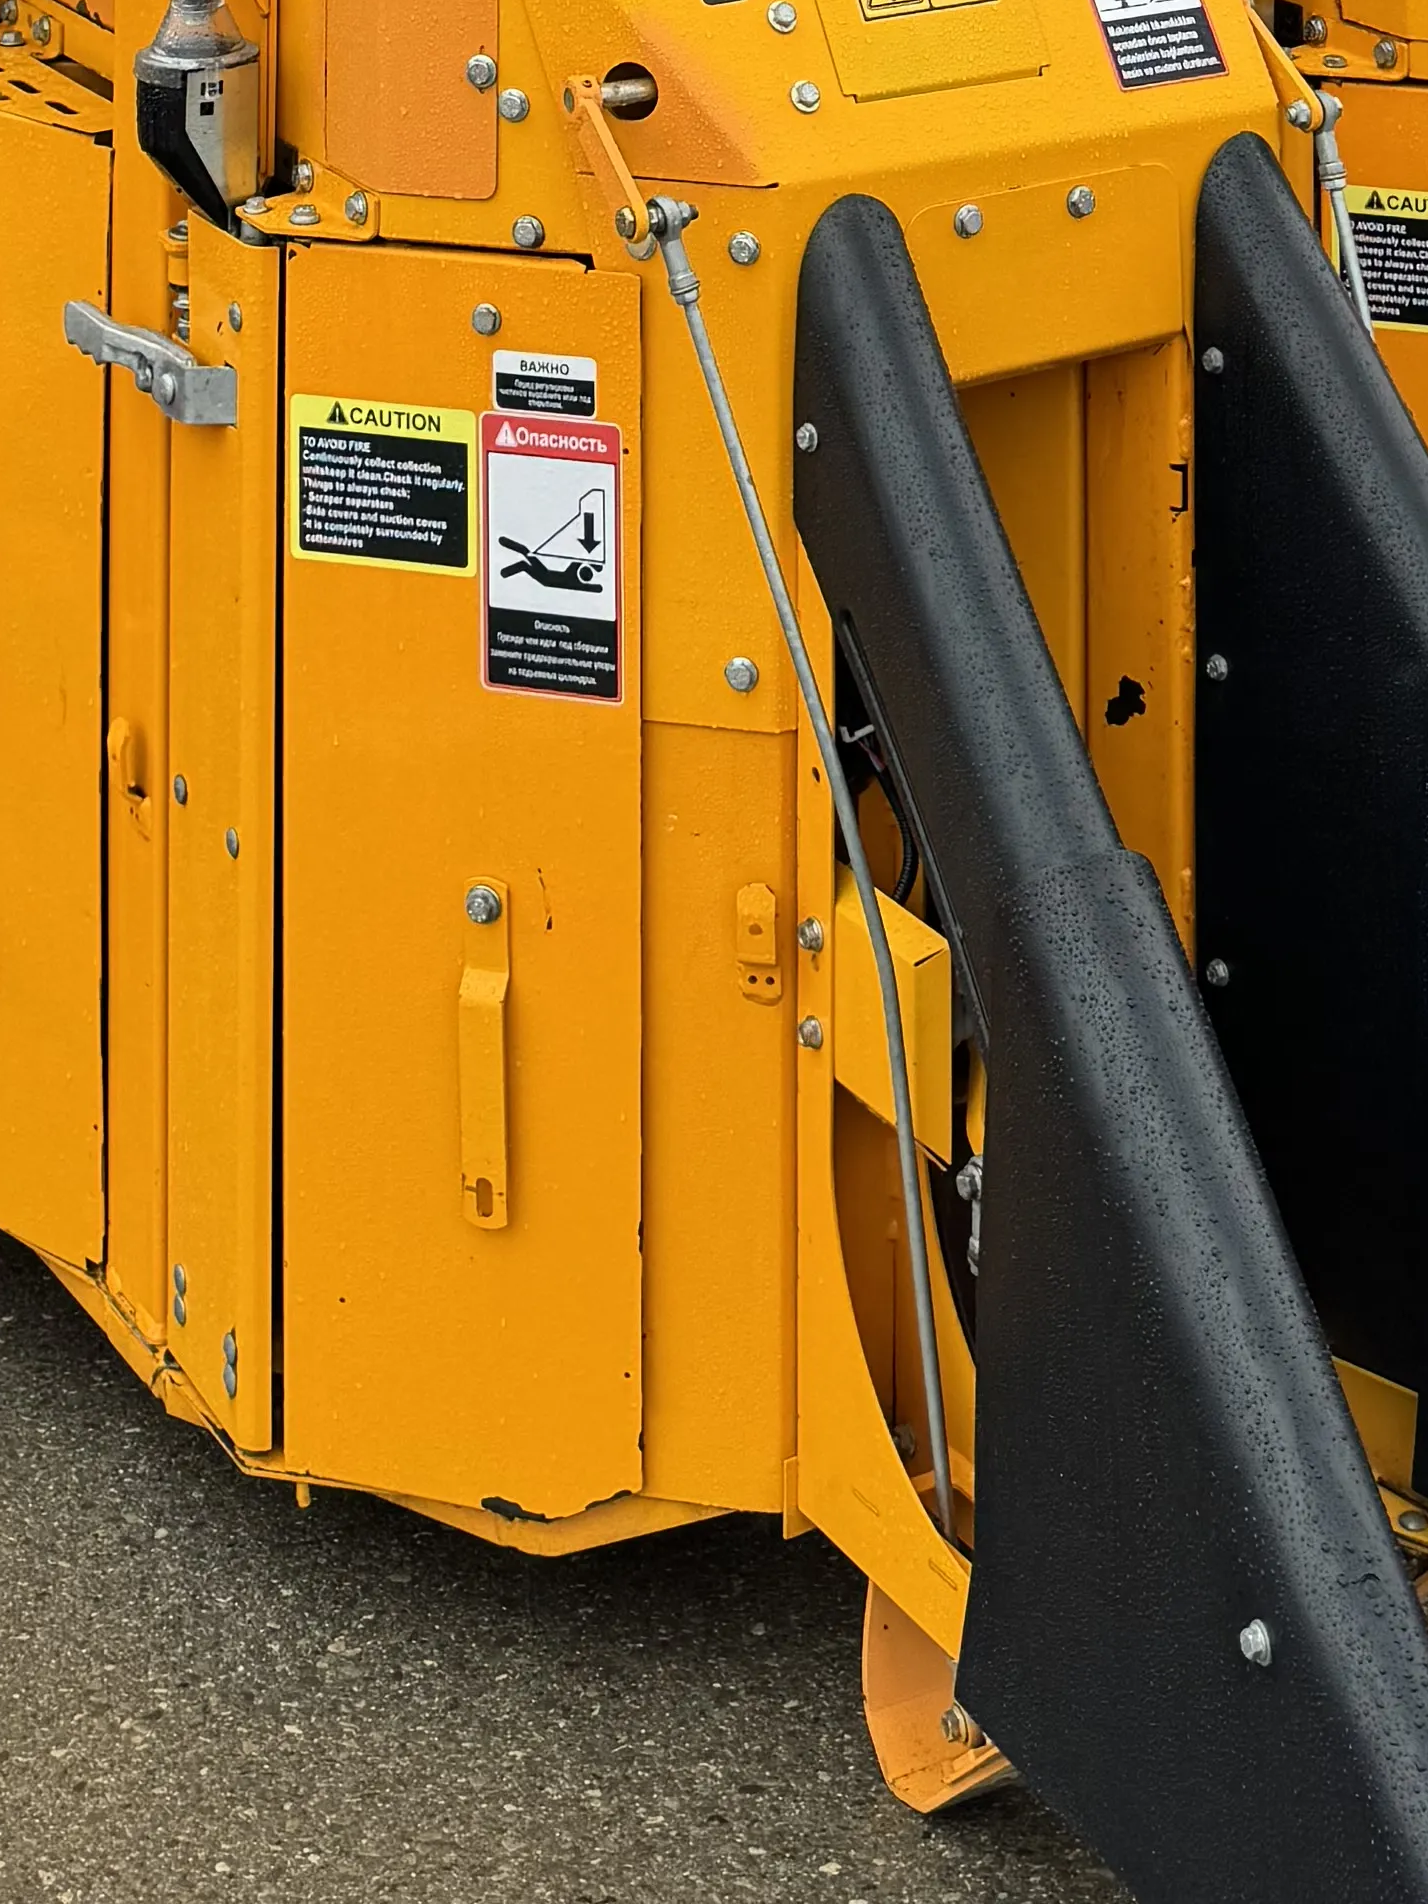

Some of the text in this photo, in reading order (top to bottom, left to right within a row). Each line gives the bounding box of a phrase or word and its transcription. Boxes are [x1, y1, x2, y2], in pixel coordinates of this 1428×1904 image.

[1356, 222, 1385, 232] AVOID
[1386, 224, 1407, 234] FIRE
[520, 360, 569, 375] ВАЖНО
[350, 407, 440, 432] CAUTION
[303, 436, 371, 452] TO AVOID FIRE
[515, 426, 608, 453] Опасность
[364, 457, 395, 469] collect
[397, 460, 441, 474] collection
[430, 531, 442, 545] by
